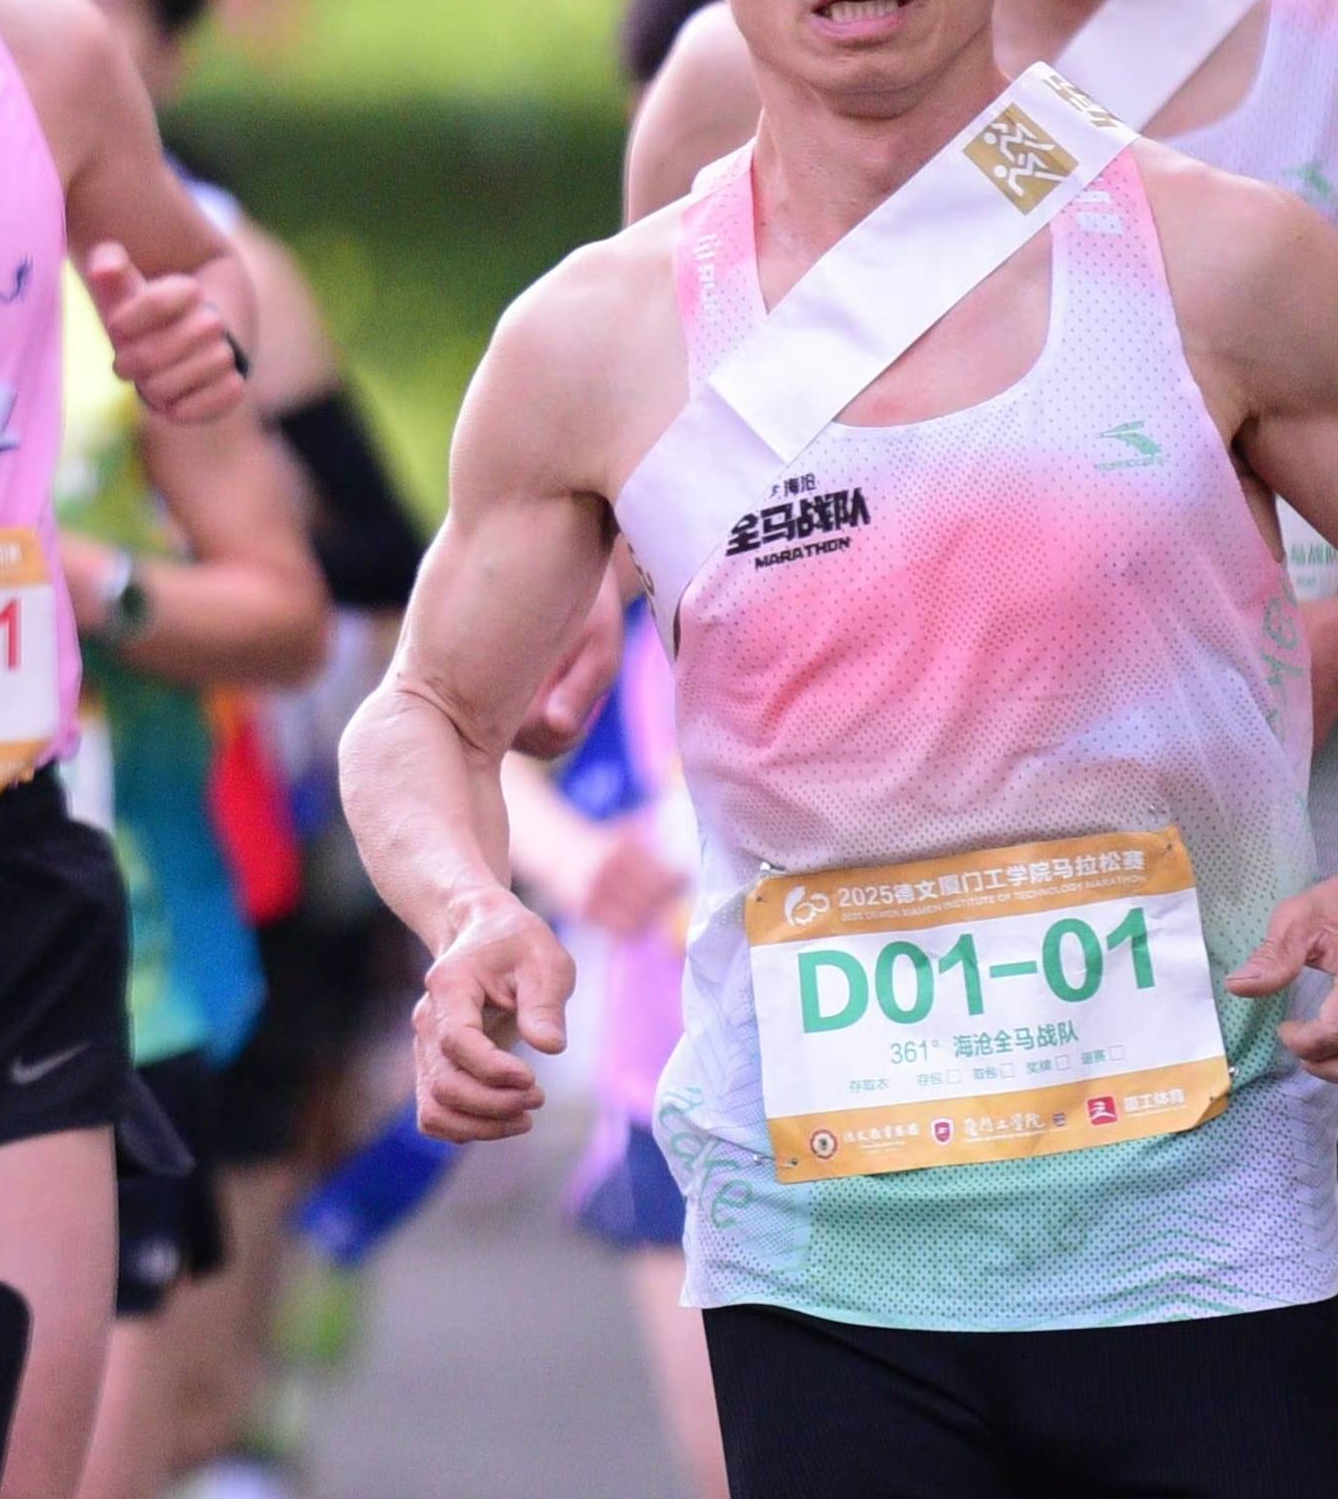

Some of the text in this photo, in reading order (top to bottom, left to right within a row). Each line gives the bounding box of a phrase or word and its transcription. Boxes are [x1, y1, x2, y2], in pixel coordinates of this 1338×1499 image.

[725, 487, 871, 557] 全马战队
[755, 537, 851, 569] MARATHON
[797, 907, 1156, 1035] D01-01
[952, 1020, 1079, 1059] 海沧全马战队
